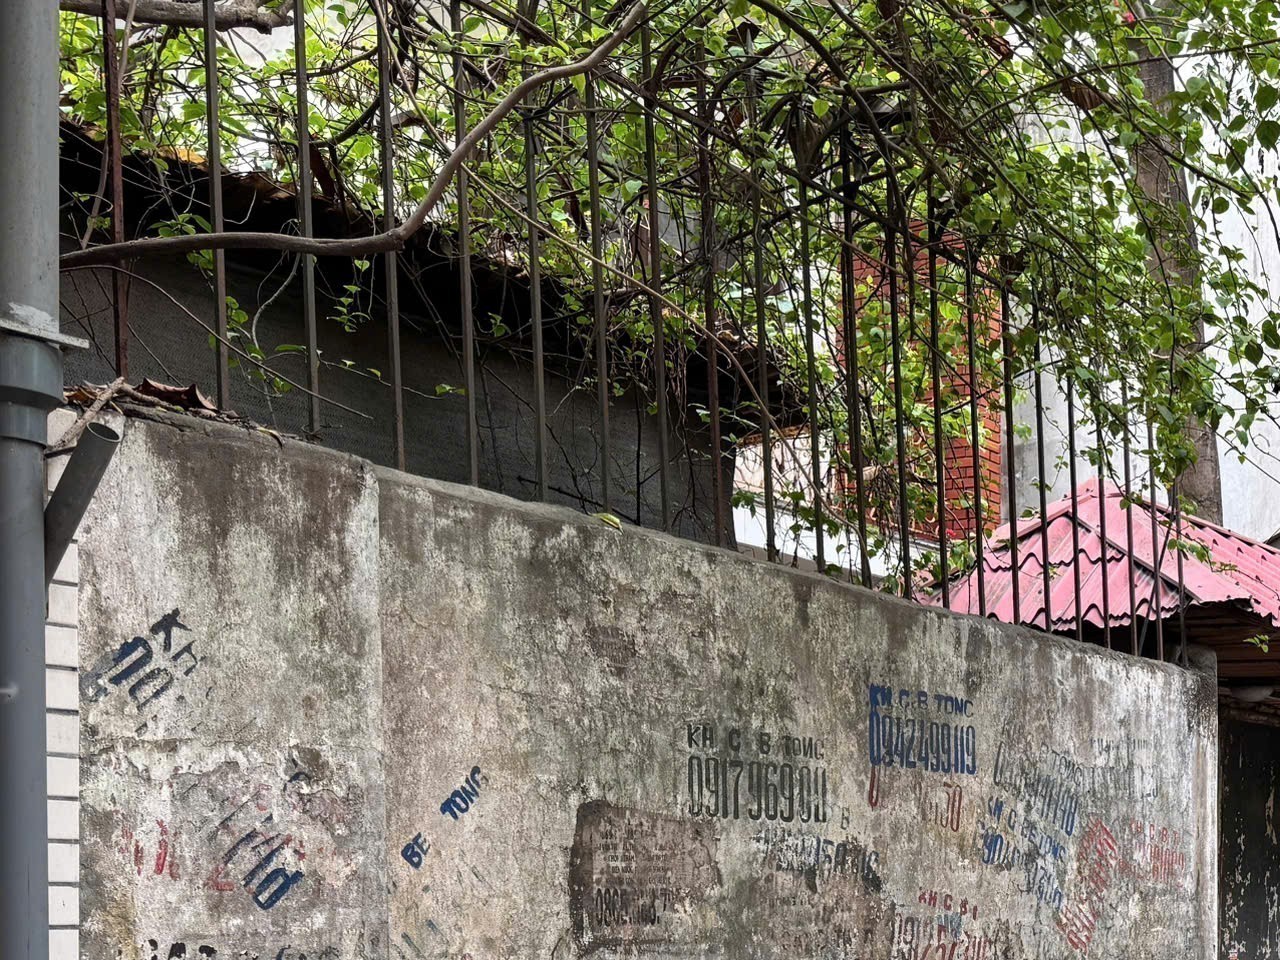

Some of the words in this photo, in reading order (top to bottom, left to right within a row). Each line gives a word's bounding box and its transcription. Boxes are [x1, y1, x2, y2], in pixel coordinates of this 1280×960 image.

[686, 723, 714, 749] KH
[759, 732, 771, 755] B
[401, 832, 432, 869] BE
